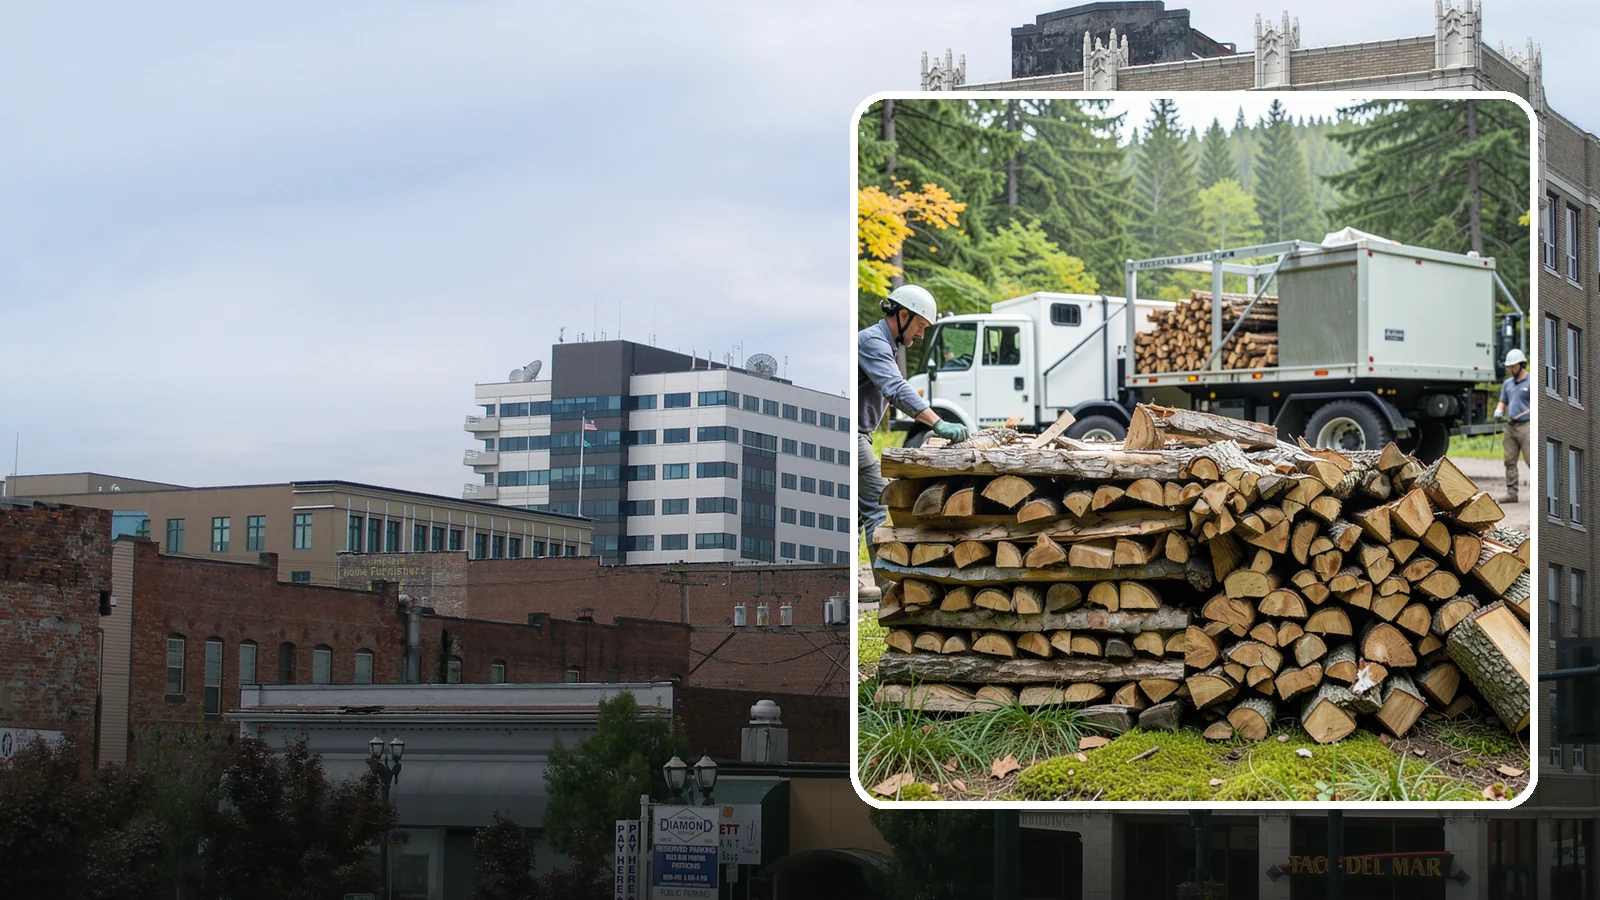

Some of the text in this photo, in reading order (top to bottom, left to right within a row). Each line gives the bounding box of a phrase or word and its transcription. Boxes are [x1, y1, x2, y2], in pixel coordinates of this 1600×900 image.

[344, 566, 427, 577] Home Furnishers
[660, 818, 713, 832] DIAMOND
[1022, 816, 1070, 827] BUILDING
[722, 852, 738, 862] Soup
[1346, 856, 1384, 875] DEL
[1392, 857, 1442, 876] MAR
[628, 856, 636, 893] HERE
[661, 889, 710, 898] PUBLIC PARKING
